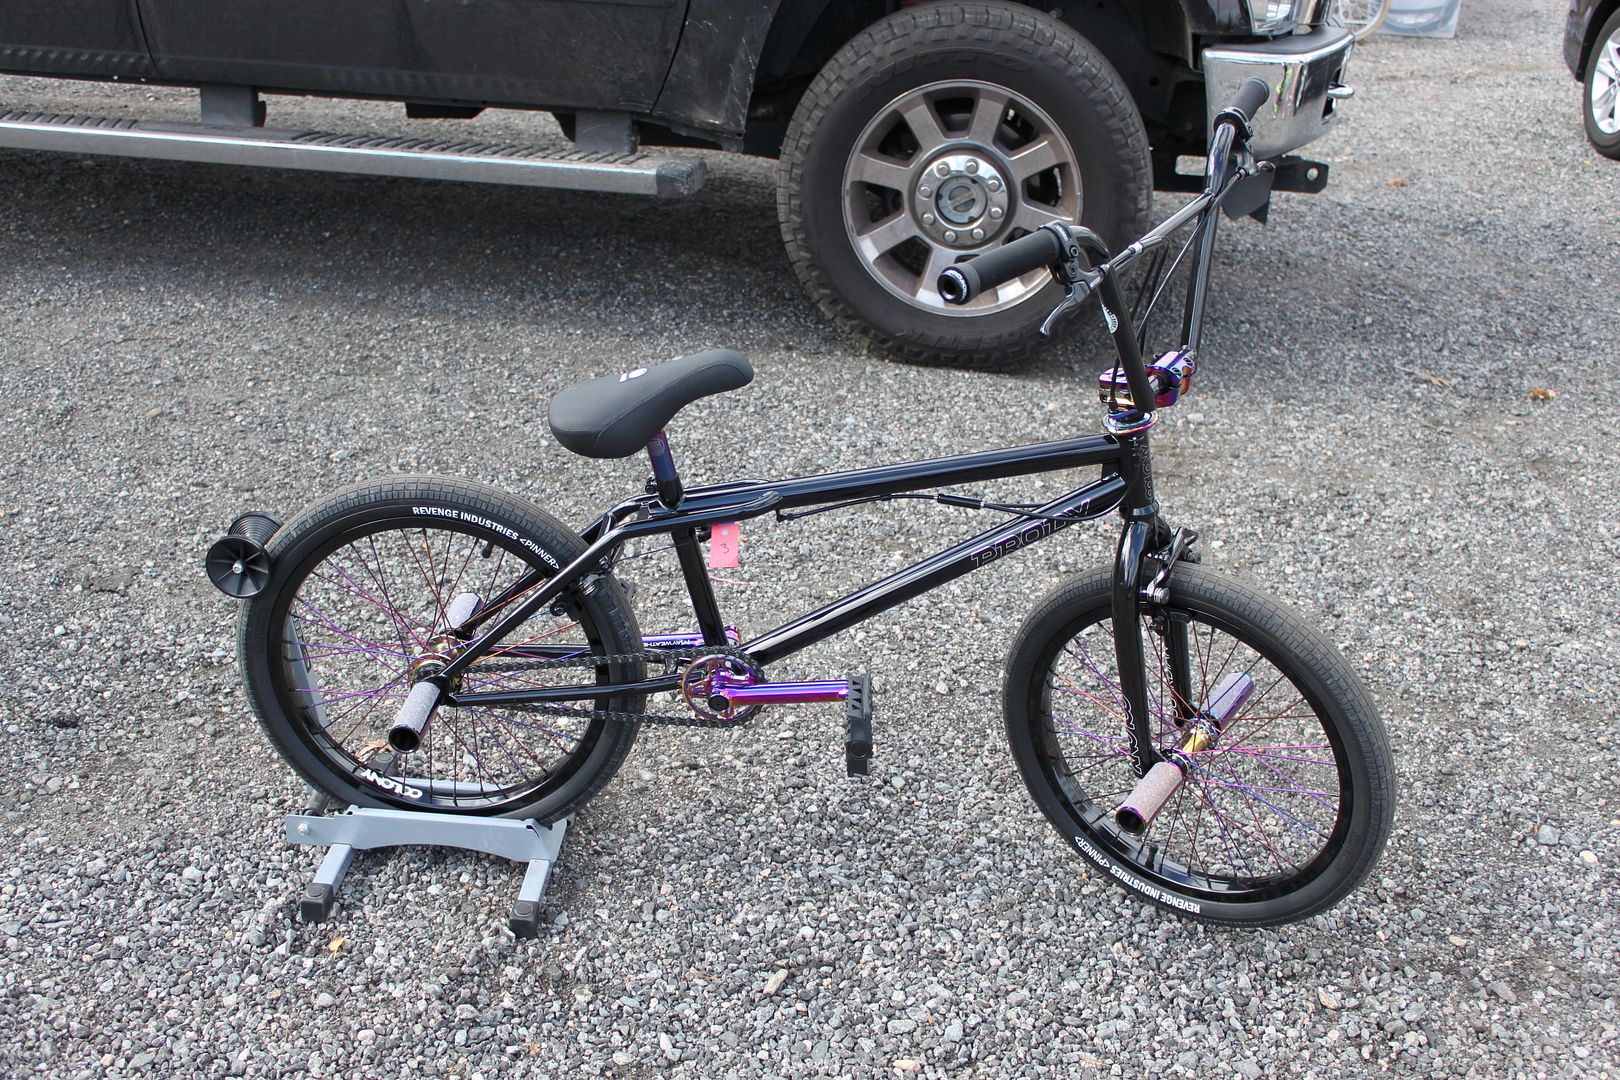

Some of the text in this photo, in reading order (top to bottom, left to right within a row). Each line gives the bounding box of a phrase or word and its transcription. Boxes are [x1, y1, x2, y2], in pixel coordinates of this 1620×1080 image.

[412, 506, 560, 570] REVENGE INDUSTRIES <PINNER>
[719, 543, 730, 554] 3
[361, 769, 423, 799] COLONY
[1074, 835, 1200, 914] REVENGE INDUSTRIES <PINNER>
